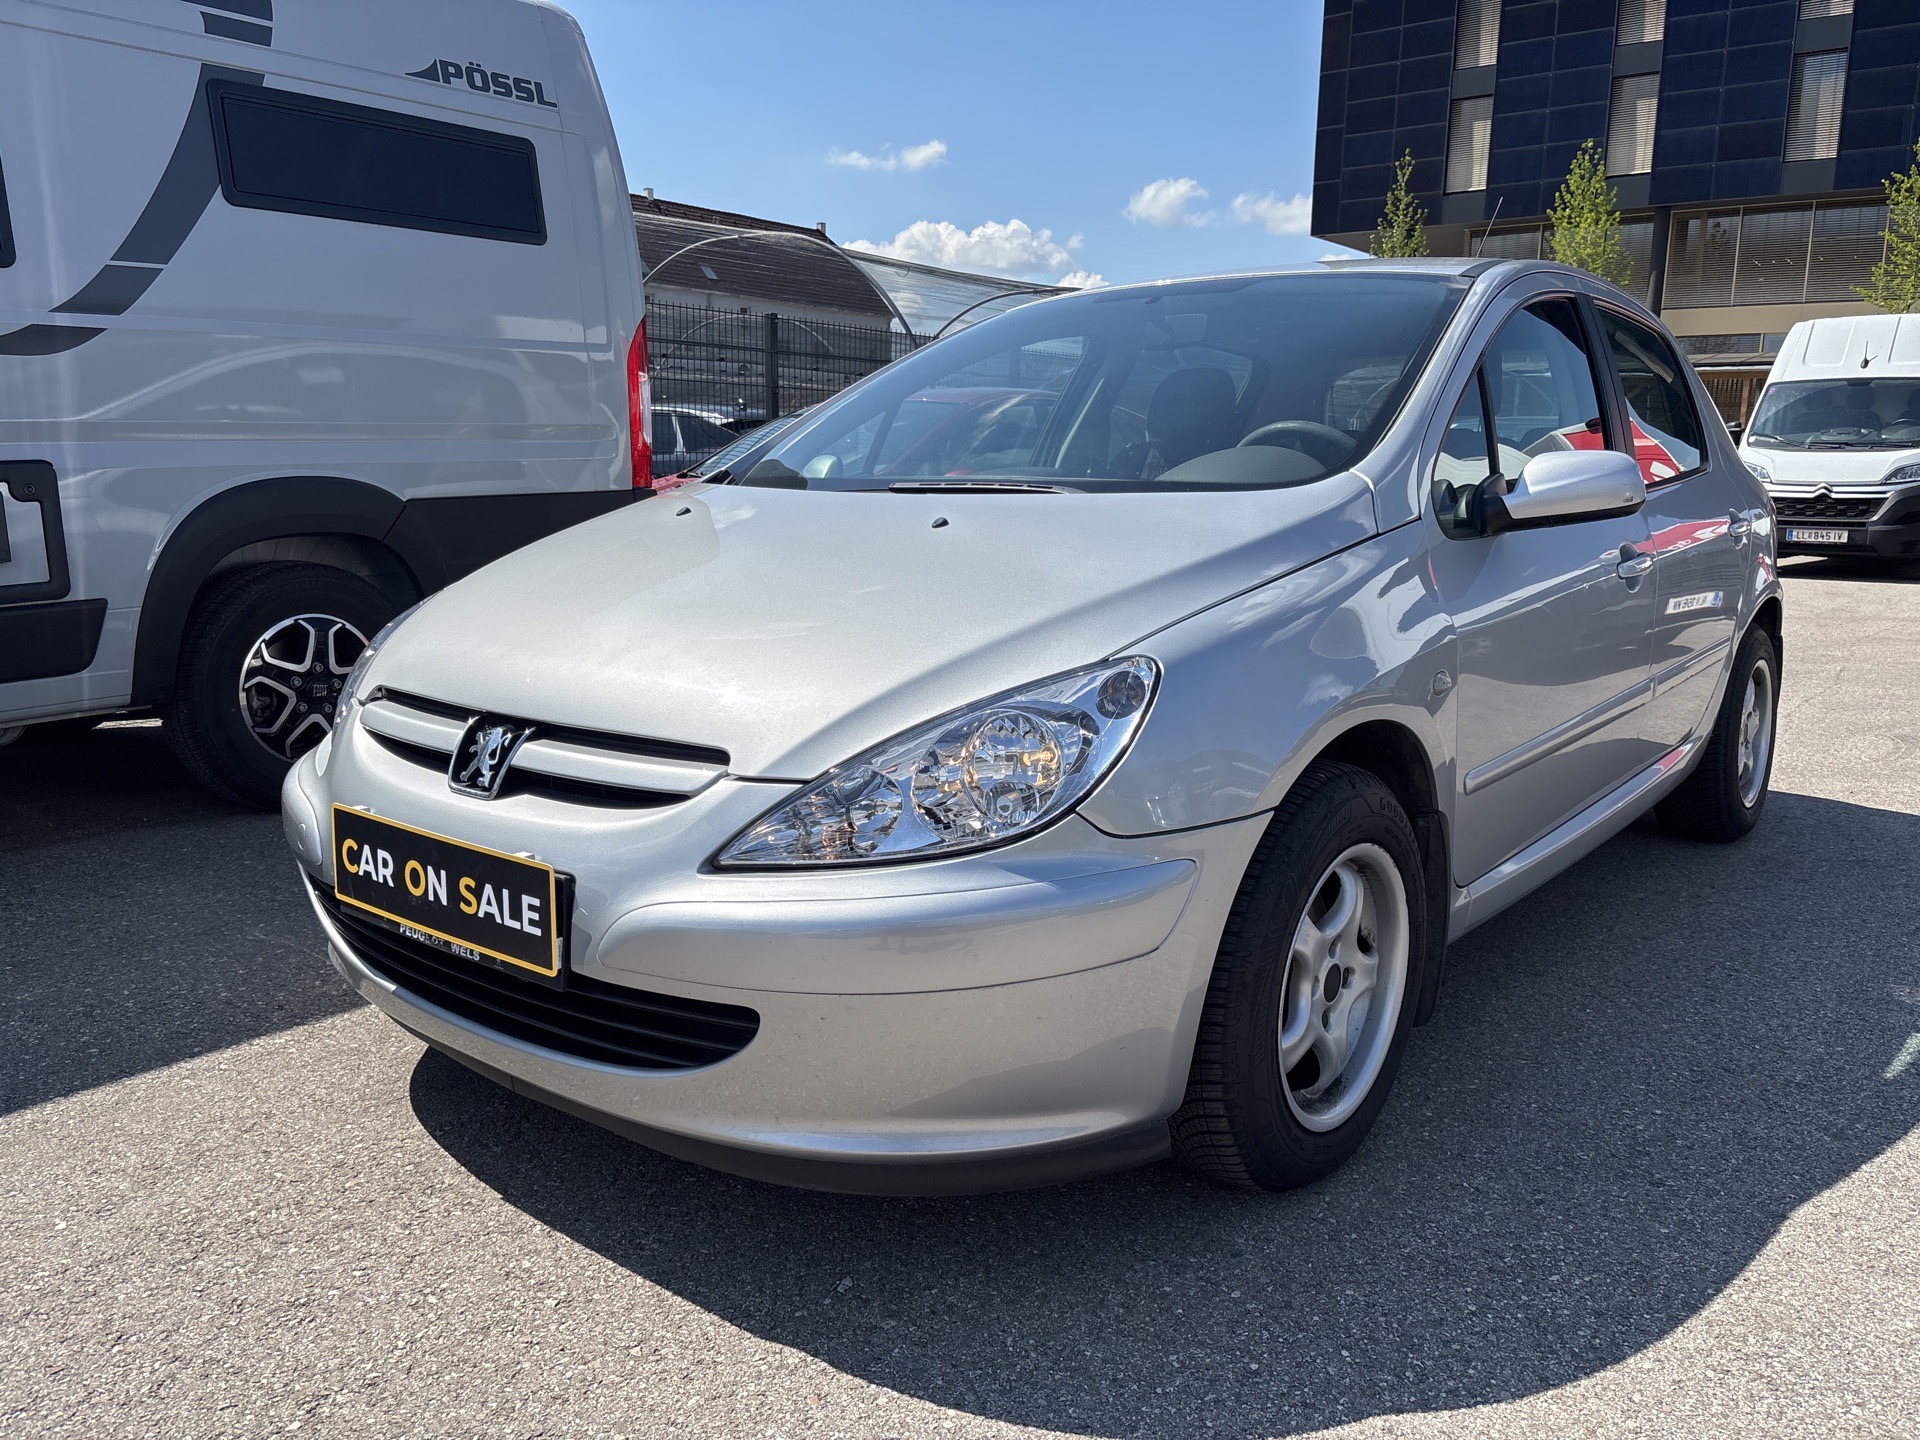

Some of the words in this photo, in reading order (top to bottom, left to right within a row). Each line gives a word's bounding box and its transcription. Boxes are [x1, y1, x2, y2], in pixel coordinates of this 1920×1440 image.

[438, 58, 558, 109] PÖSSL
[1796, 531, 1807, 540] LL
[1813, 531, 1831, 541] 845
[1833, 532, 1843, 541] IV
[313, 684, 329, 697] FIAT
[341, 838, 395, 888] CAR
[404, 859, 448, 907] ON
[458, 876, 542, 937] SALE
[450, 942, 481, 961] WELS
